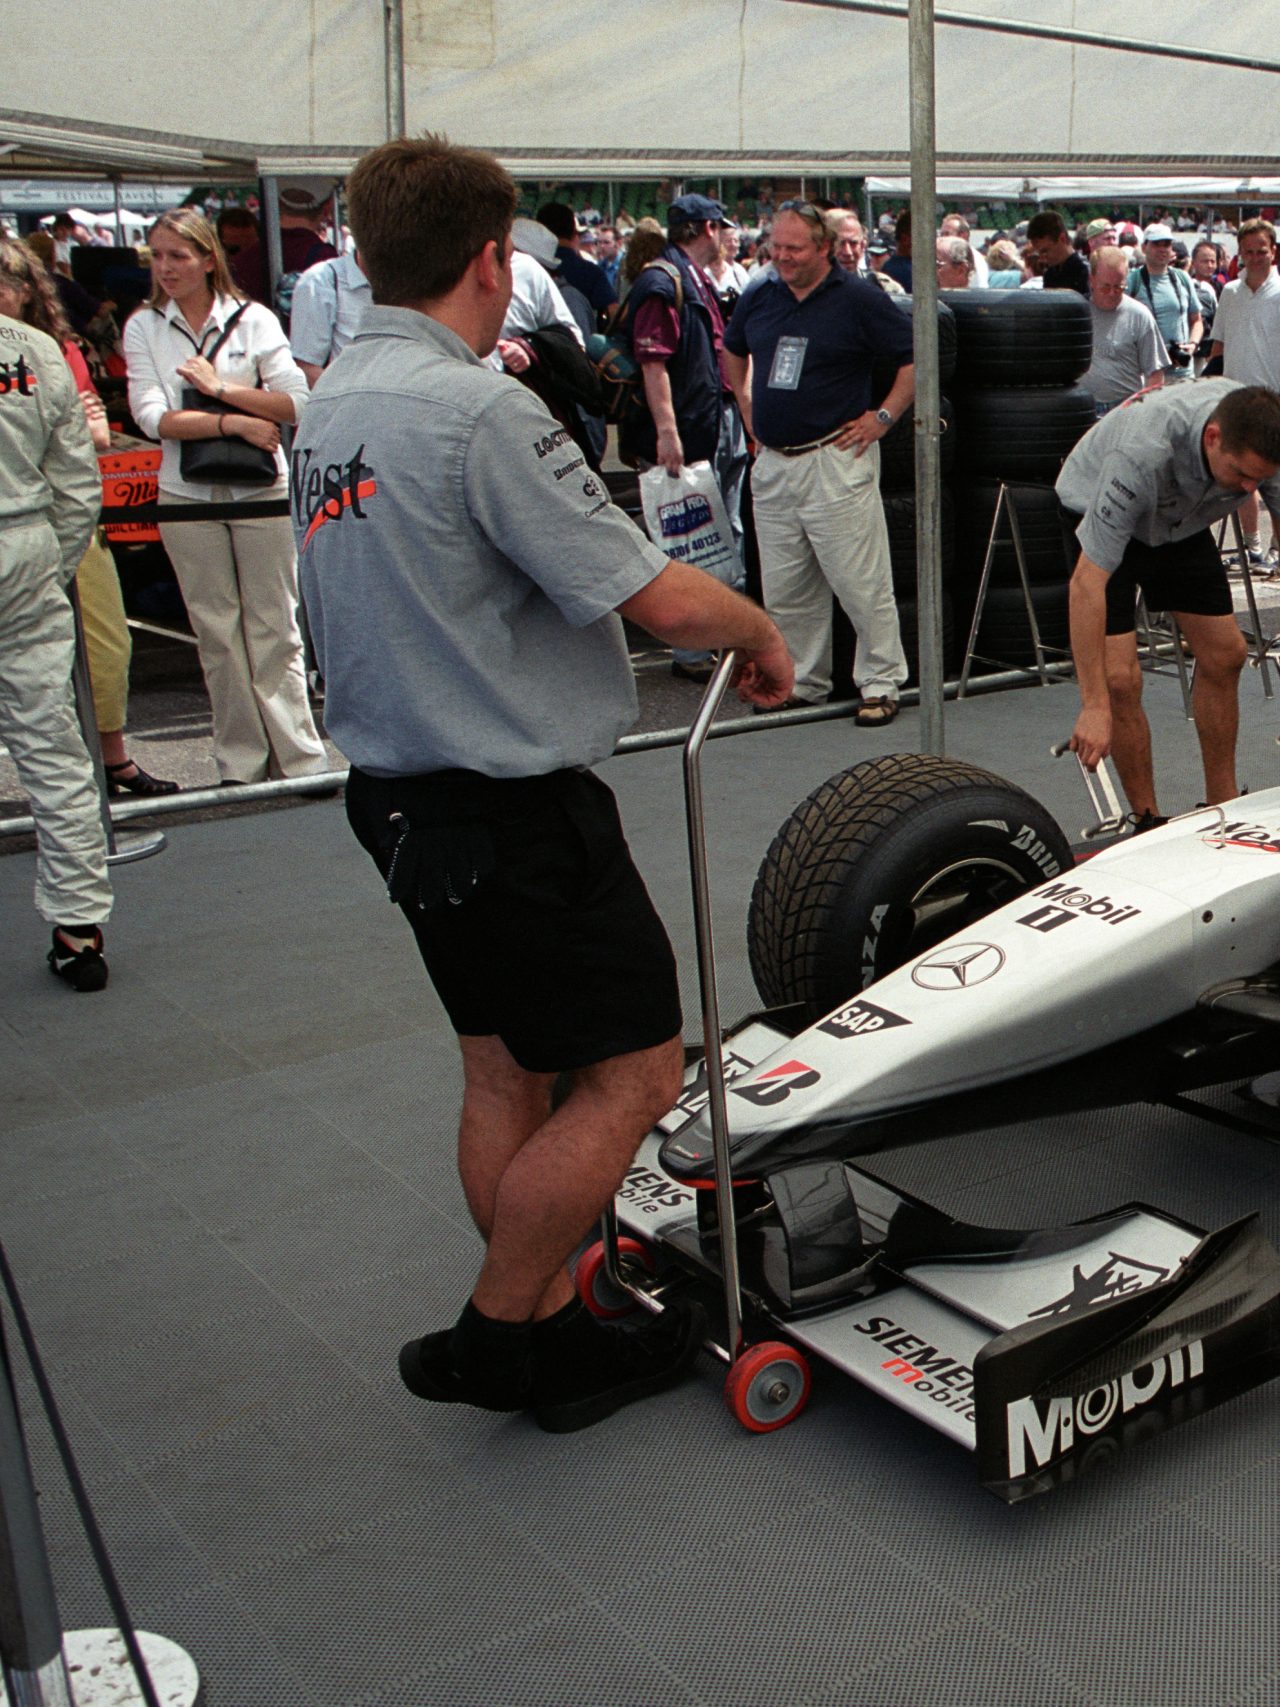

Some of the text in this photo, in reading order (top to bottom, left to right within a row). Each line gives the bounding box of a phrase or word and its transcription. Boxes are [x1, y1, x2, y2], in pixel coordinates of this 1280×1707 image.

[1033, 883, 1142, 926] Mobil
[832, 1004, 885, 1034] SAP
[616, 1188, 659, 1214] bile
[853, 1315, 976, 1400] SIEME
[880, 1355, 977, 1423] mobile
[1006, 1338, 1204, 1480] Mobil
